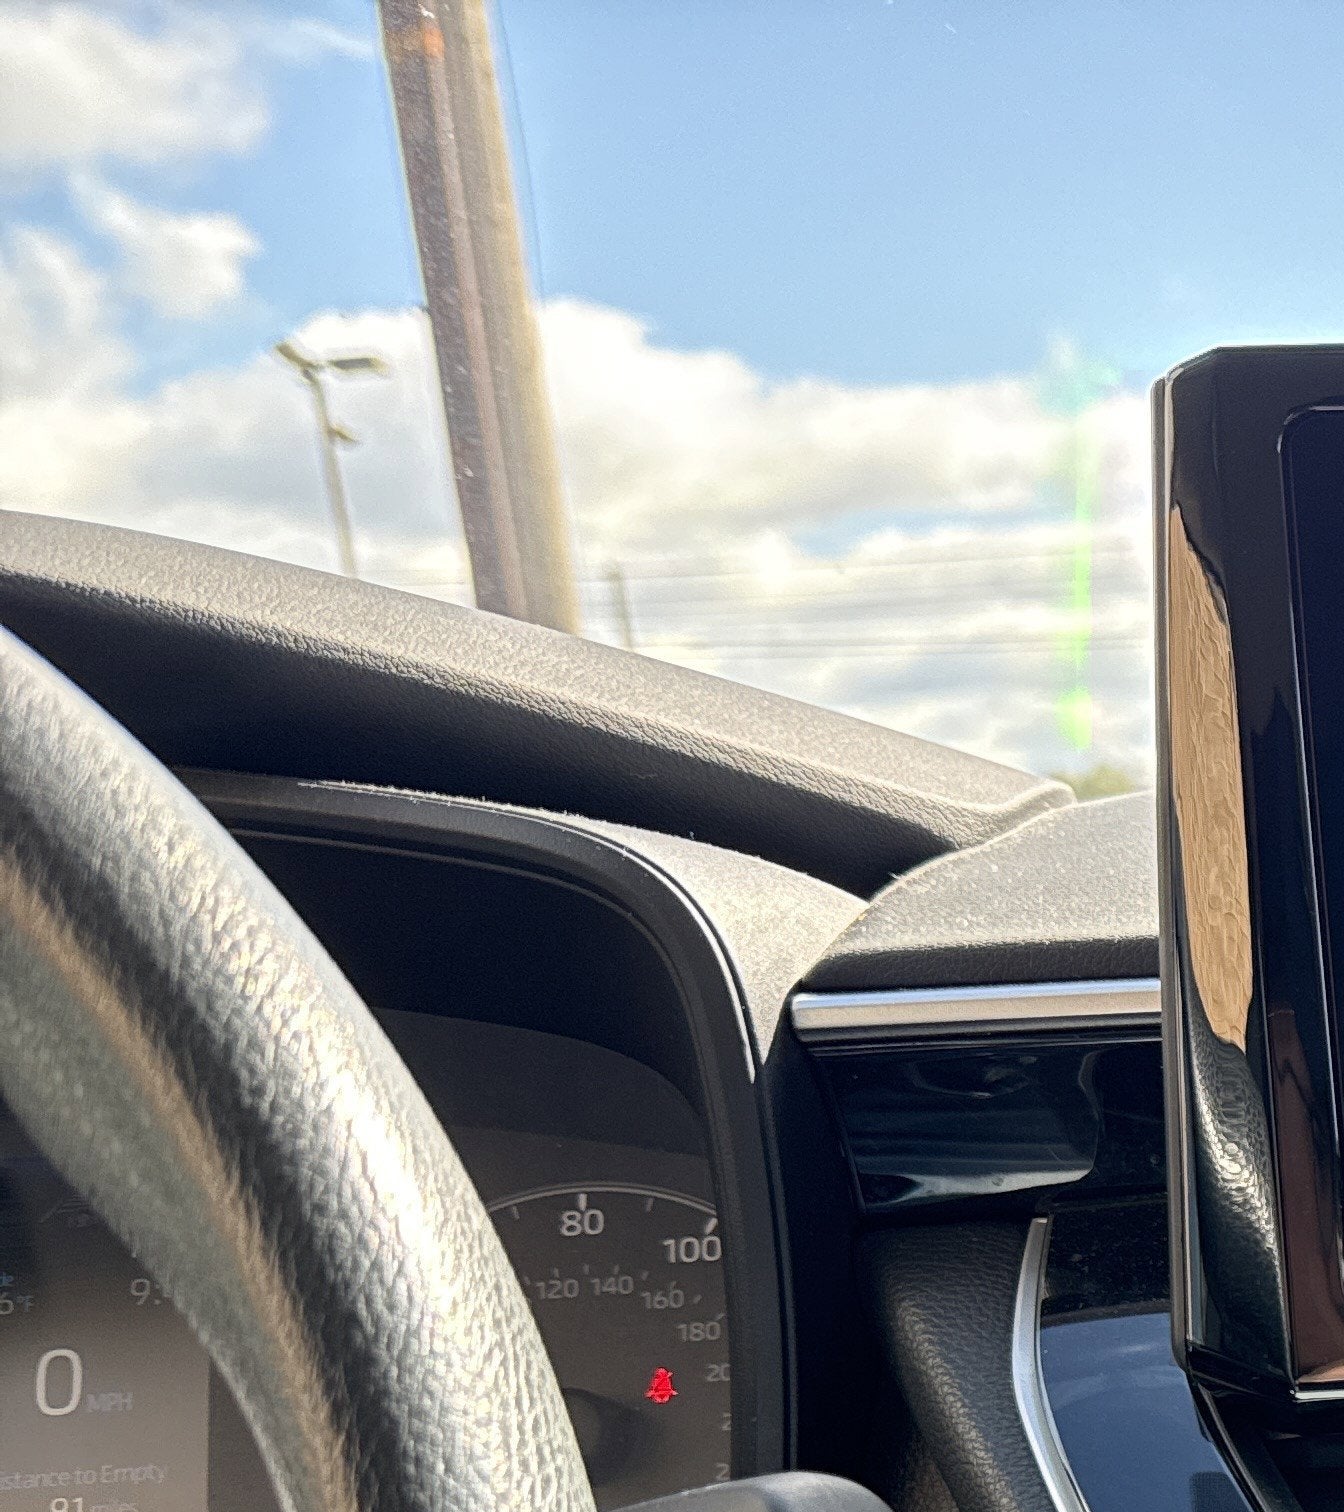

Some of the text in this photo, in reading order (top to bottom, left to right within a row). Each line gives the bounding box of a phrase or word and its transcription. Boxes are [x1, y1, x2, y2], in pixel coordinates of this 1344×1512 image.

[560, 1208, 605, 1237] 80
[662, 1234, 723, 1264] 100
[536, 1278, 580, 1300] 120
[590, 1275, 635, 1296] 140
[641, 1289, 686, 1310] 160
[676, 1321, 722, 1343] 180
[36, 1349, 82, 1416] 0
[74, 1466, 99, 1485] to
